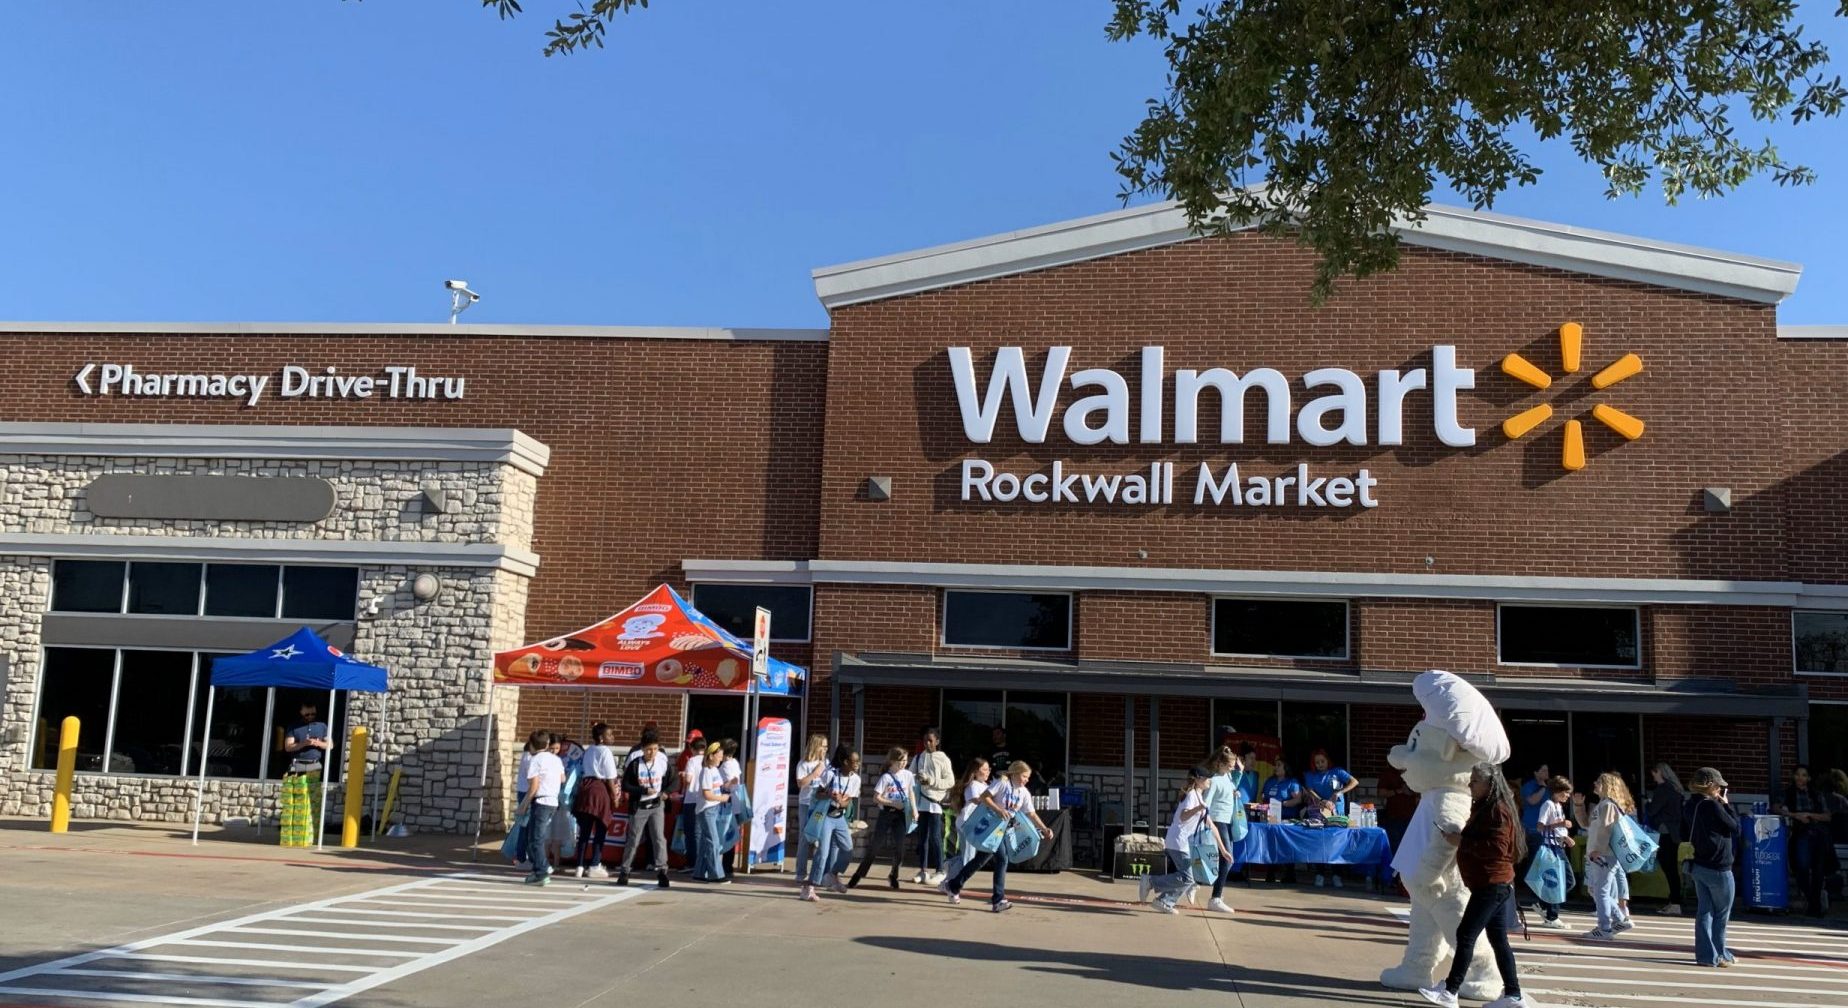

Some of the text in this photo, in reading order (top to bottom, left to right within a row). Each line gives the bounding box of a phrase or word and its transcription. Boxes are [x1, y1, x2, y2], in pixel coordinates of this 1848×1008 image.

[100, 364, 465, 406] Pharmacy Drive-Thru
[947, 345, 1477, 448] Walmart
[961, 459, 1379, 508] Rockwall Market
[603, 666, 642, 675] BIMBO
